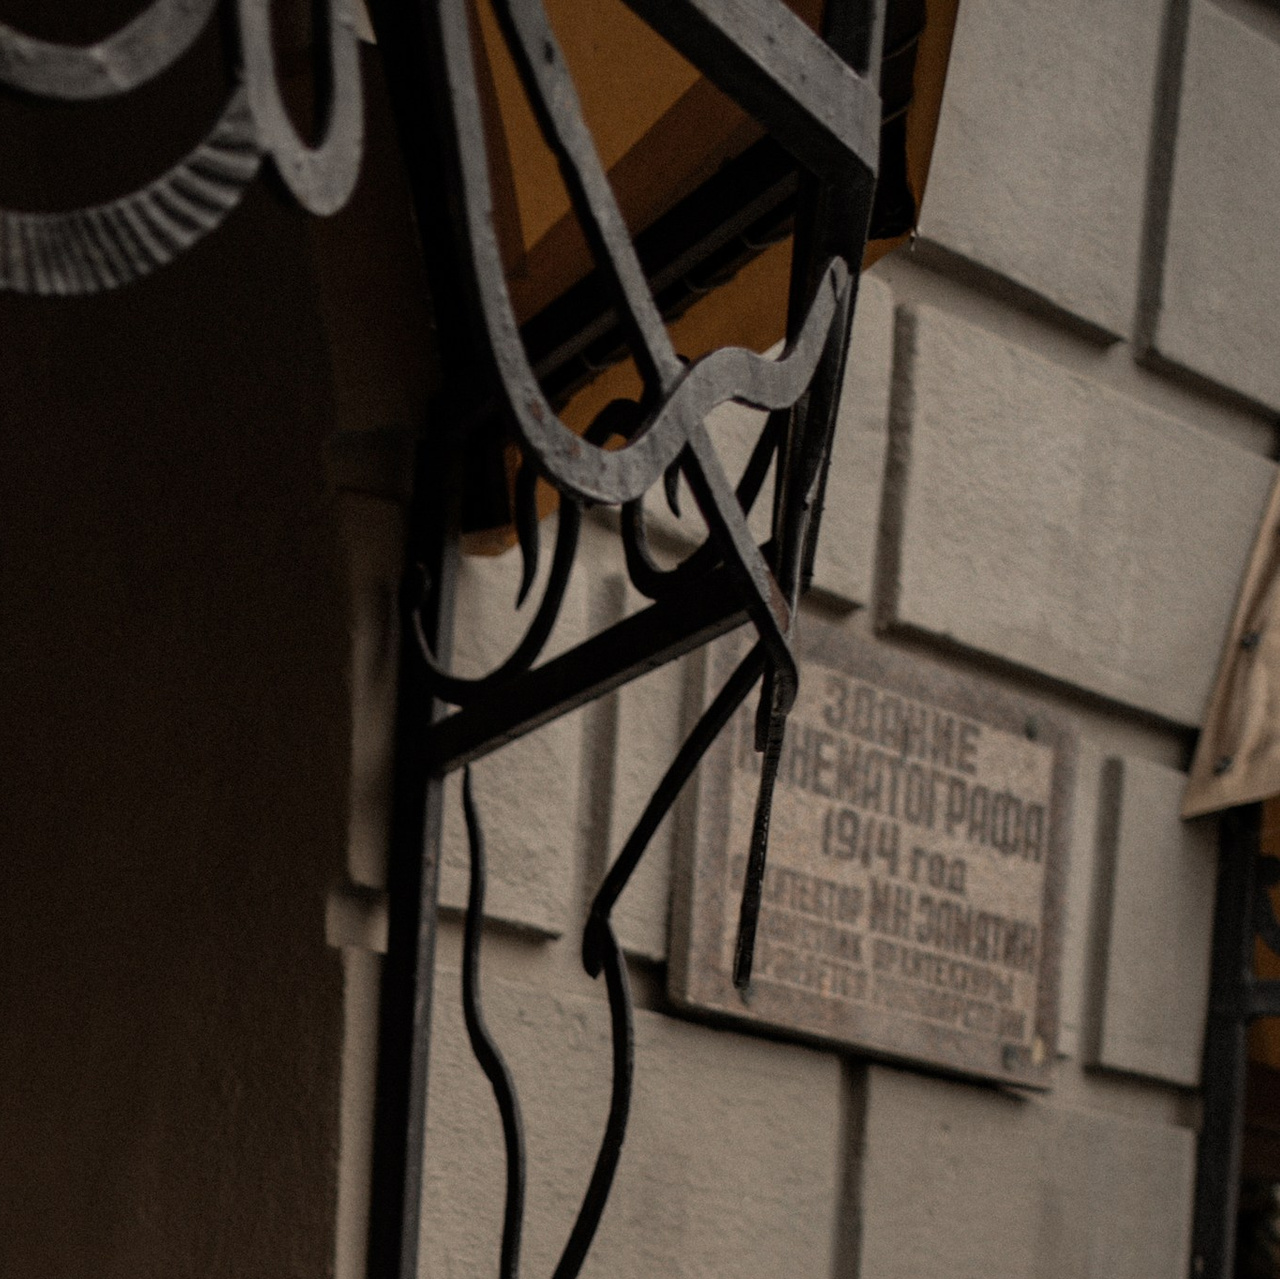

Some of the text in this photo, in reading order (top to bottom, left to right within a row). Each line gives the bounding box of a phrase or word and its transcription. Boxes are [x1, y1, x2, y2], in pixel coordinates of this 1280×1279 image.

[824, 675, 982, 776] ЗДАНИЕ
[737, 704, 1045, 864] КНЕМАТОГРАФА
[822, 807, 901, 877] 1914
